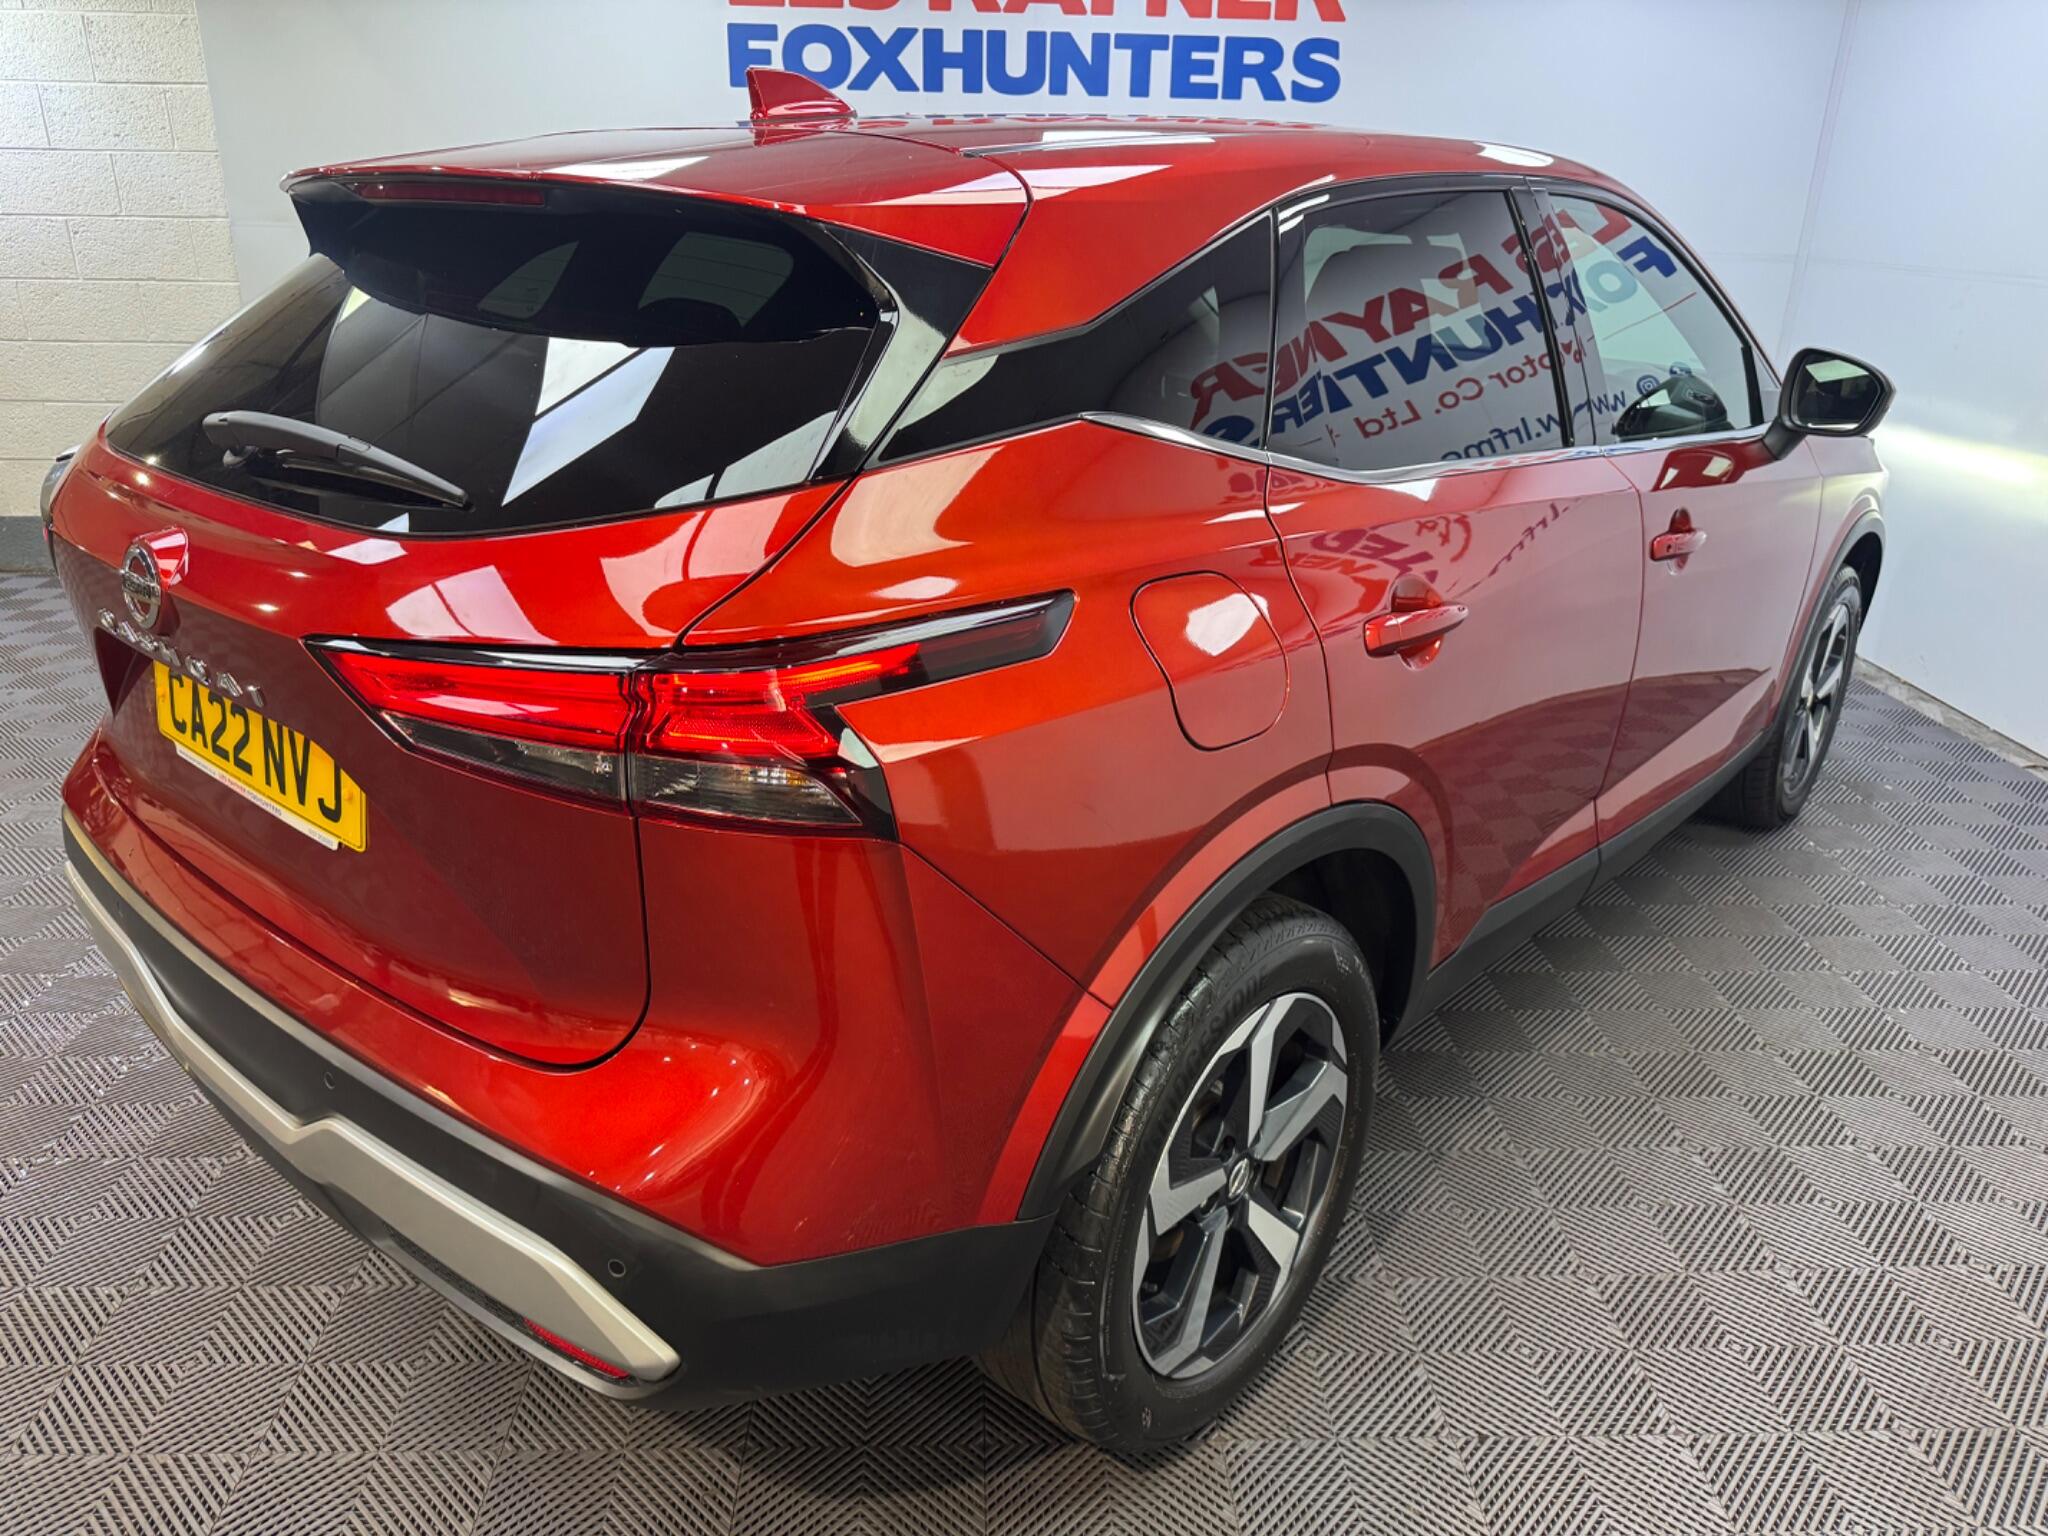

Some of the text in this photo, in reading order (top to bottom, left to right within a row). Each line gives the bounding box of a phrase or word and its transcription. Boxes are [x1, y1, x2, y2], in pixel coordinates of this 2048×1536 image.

[727, 22, 1341, 103] FOXHUNTERS
[168, 667, 253, 777] CA22
[262, 716, 342, 824] NVJ
